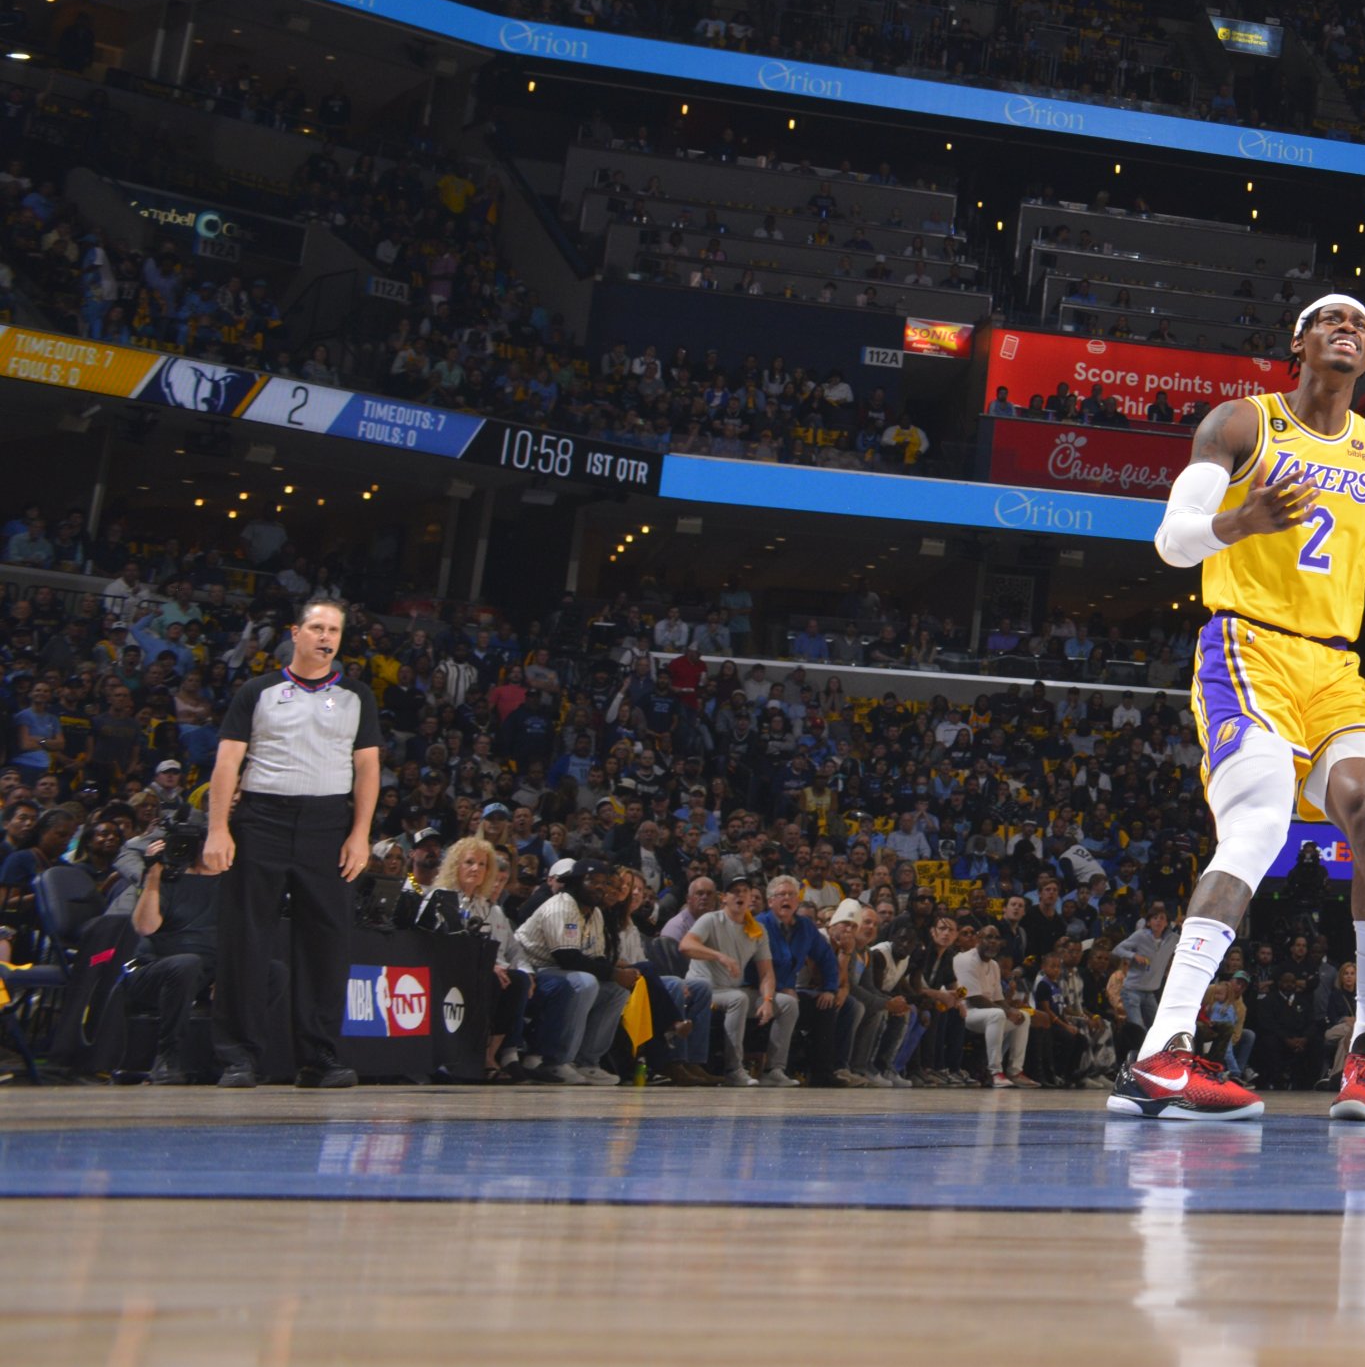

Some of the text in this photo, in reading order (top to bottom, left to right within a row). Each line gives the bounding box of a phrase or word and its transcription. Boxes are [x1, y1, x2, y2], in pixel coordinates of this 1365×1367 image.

[500, 20, 588, 60] Orion
[757, 62, 842, 97] Orion
[1003, 94, 1084, 131] Orion
[1237, 129, 1313, 163] Orion
[16, 334, 100, 366] TIMEOUTS:
[909, 327, 958, 343] SONIC
[7, 358, 66, 385] FOULS:
[868, 350, 899, 364] 112A
[1074, 362, 1266, 397] Score points with
[286, 386, 445, 431] 2 TIMEOUTS: 7
[357, 420, 417, 447] FOULS: 0
[500, 427, 574, 477] 10:58
[615, 456, 649, 484] QTR
[994, 490, 1092, 530] Orion
[1297, 505, 1336, 574] 2
[347, 979, 374, 1021] NBA
